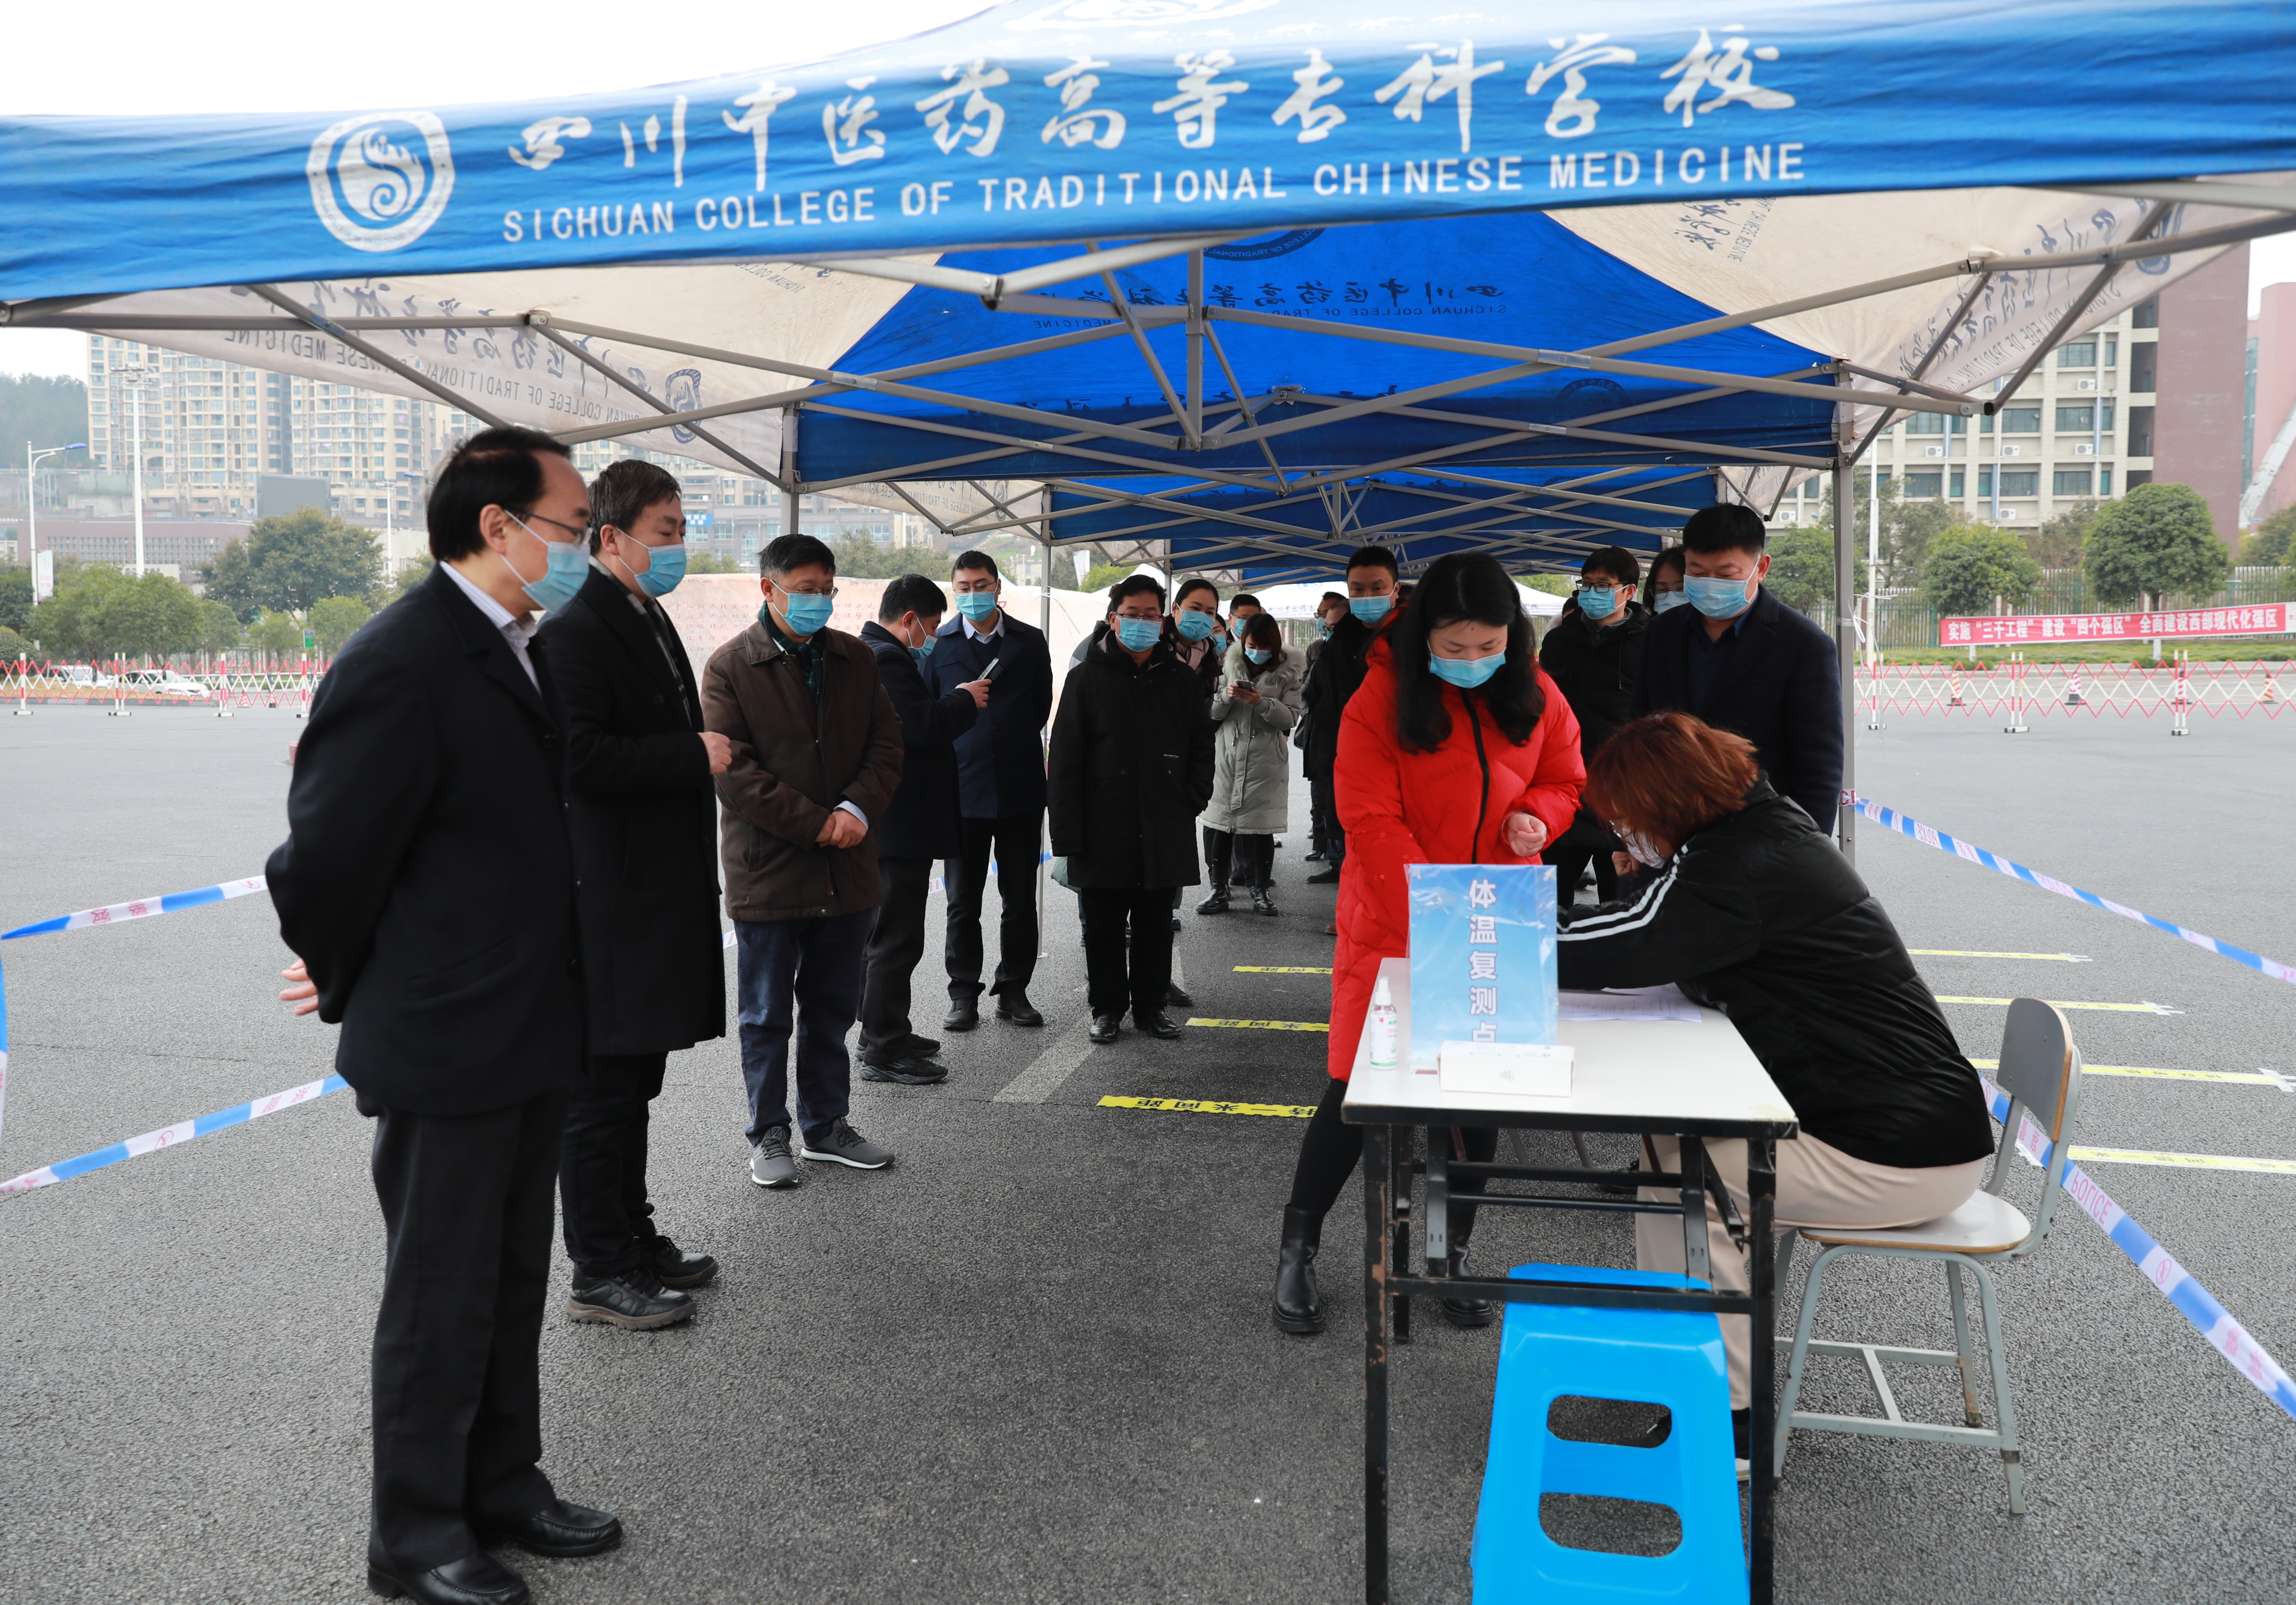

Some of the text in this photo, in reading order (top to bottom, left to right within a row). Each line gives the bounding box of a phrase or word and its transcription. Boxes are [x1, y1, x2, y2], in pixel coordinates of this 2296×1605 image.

[508, 26, 1795, 191] 四川中医药高等专科学校
[503, 143, 1806, 242] SICHUAN COLLEGE OF TRADITIONAL CHINESE MEDICINE
[1948, 621, 1971, 641] 实施
[2042, 618, 2066, 637] 建设
[2139, 608, 2278, 633] 全面建设西部现代化强区
